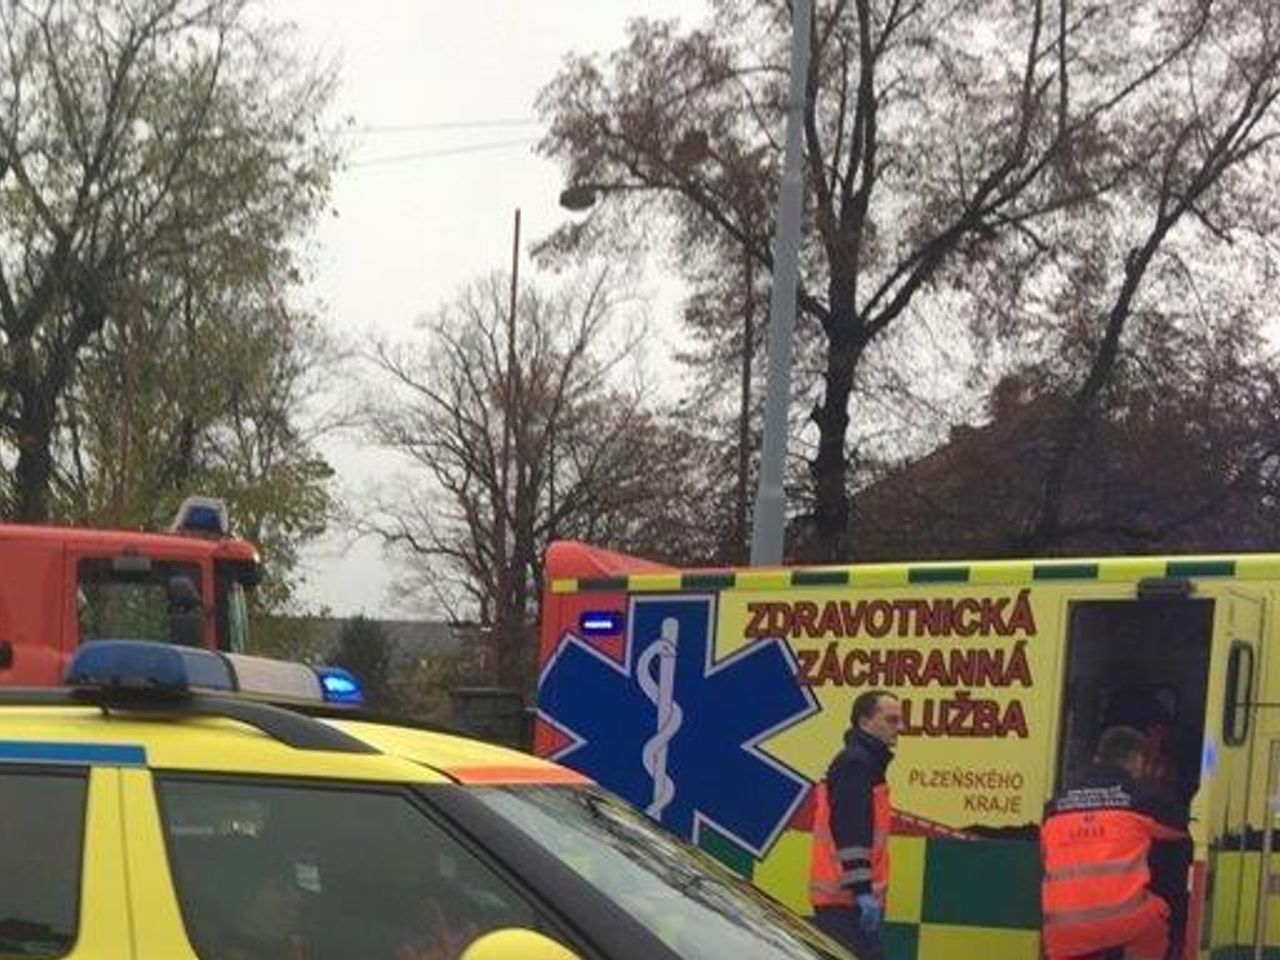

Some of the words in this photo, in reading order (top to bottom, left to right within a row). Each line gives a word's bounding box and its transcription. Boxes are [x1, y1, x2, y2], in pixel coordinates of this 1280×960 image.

[744, 589, 1037, 638] ZDRAVOTNICKÁ
[797, 641, 1033, 687] ZÁCHRANNÁ
[896, 691, 1029, 738] LUŽBA
[909, 766, 1025, 791] PLZEŇSKÉHO
[963, 795, 1022, 813] KRAJE
